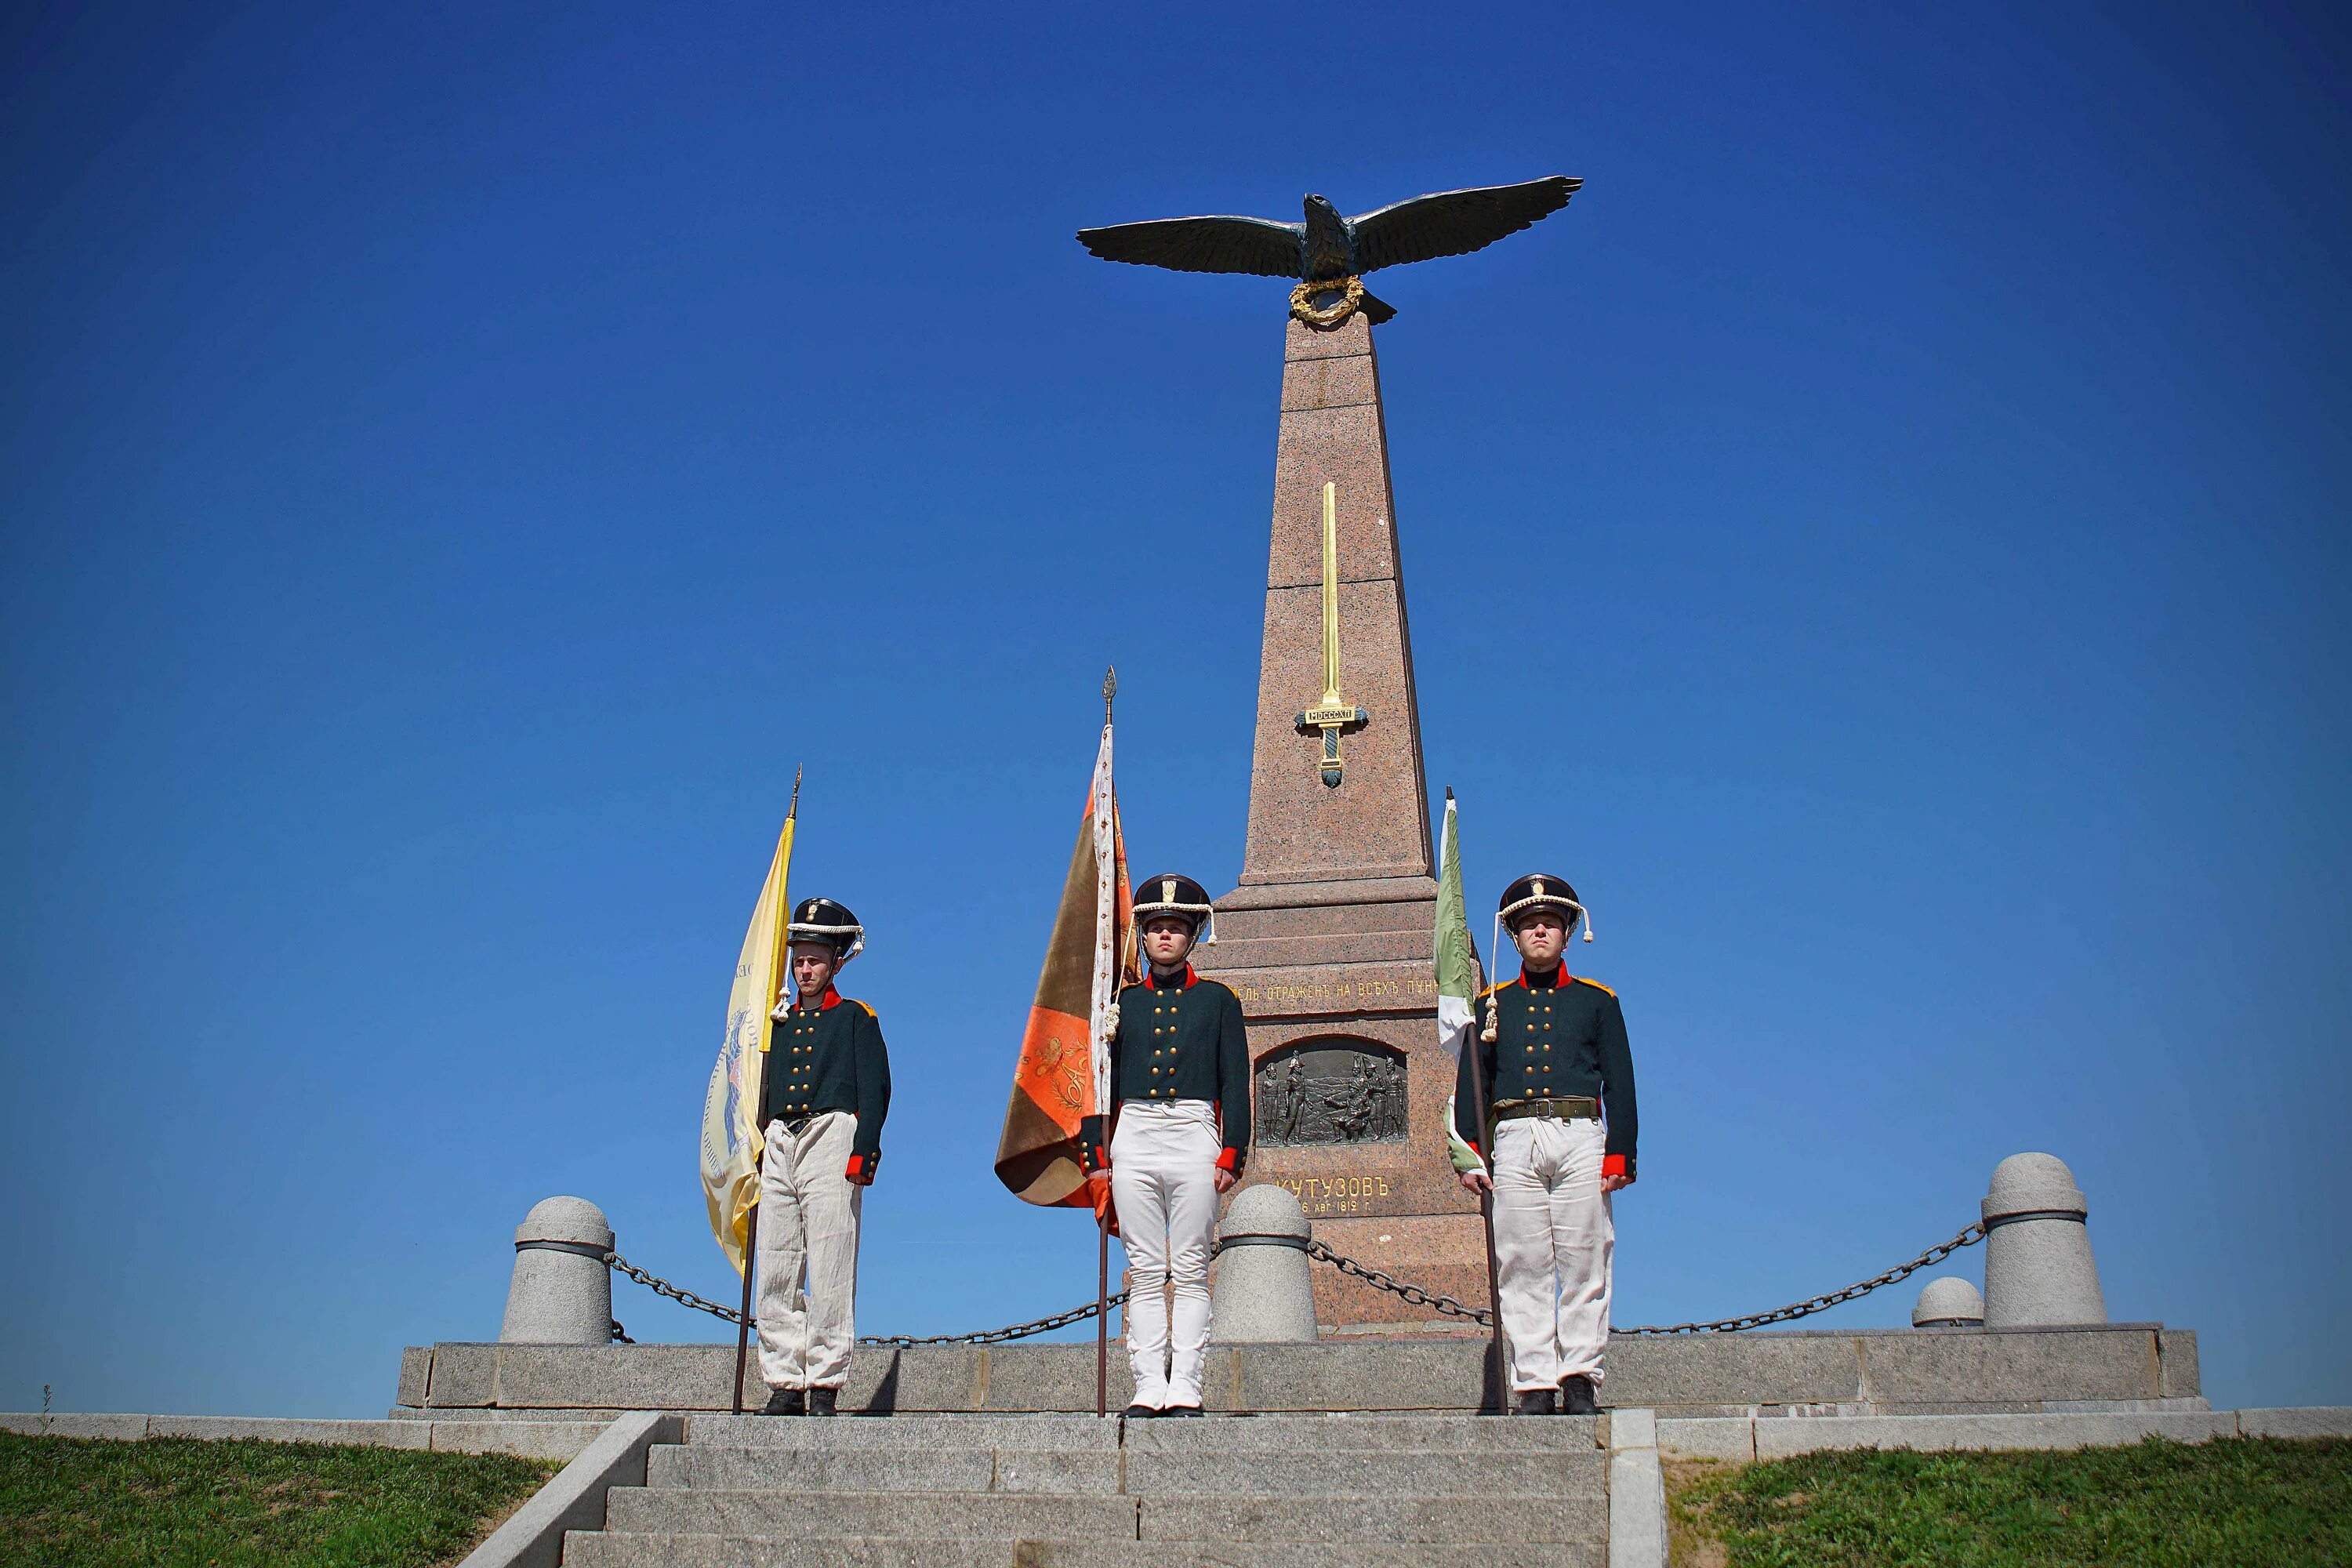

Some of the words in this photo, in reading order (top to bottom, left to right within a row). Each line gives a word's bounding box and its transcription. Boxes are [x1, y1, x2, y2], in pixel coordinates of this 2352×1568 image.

[1311, 710, 1350, 720] MDCCCXII
[1233, 987, 1259, 1001] ЕЛЬ
[1267, 985, 1330, 1000] ОТРАЖЕНЪ
[1337, 983, 1351, 996] НА
[1337, 1200, 1358, 1211] 1812
